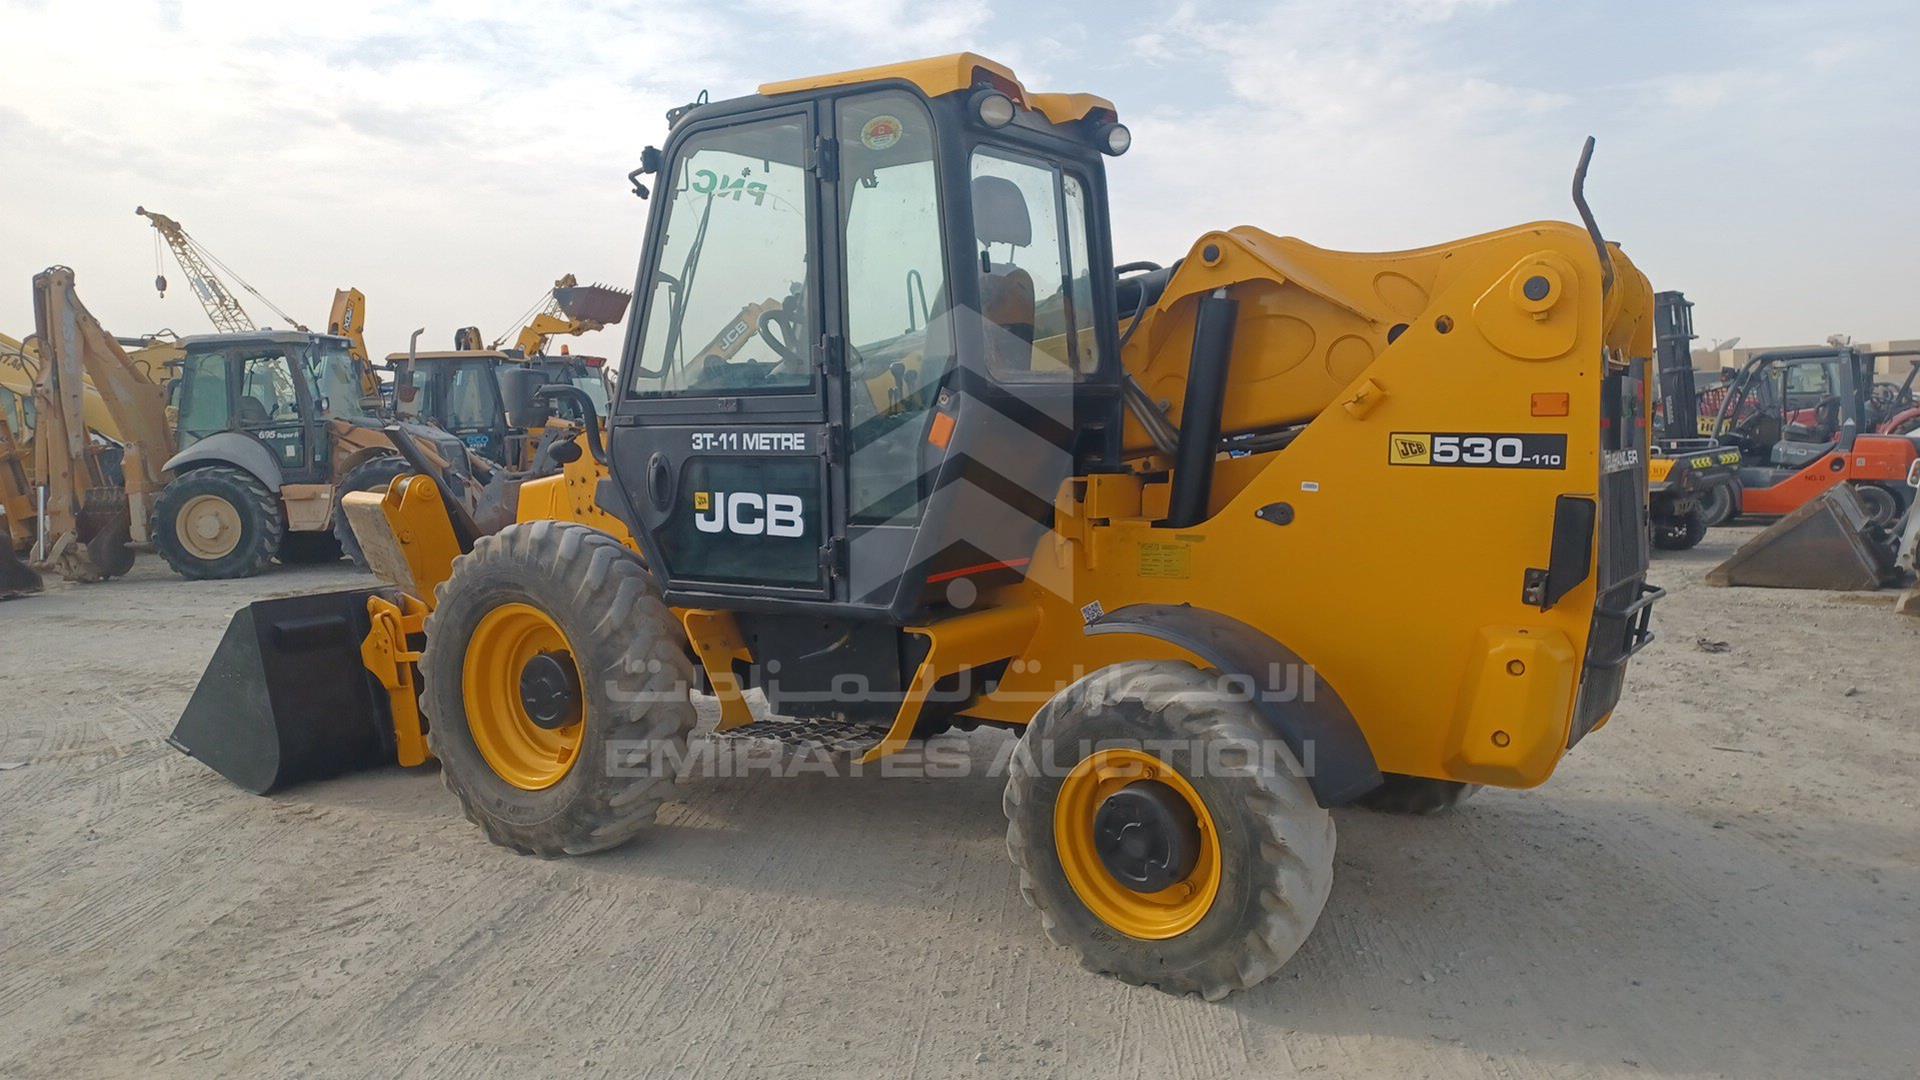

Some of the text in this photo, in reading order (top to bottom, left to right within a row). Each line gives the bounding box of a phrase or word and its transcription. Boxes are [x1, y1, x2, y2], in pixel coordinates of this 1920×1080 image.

[722, 321, 747, 349] JCB
[258, 430, 276, 440] 695
[692, 433, 805, 450] 3T-11 METRE
[1400, 441, 1425, 457] JCB
[695, 492, 804, 538] JCB
